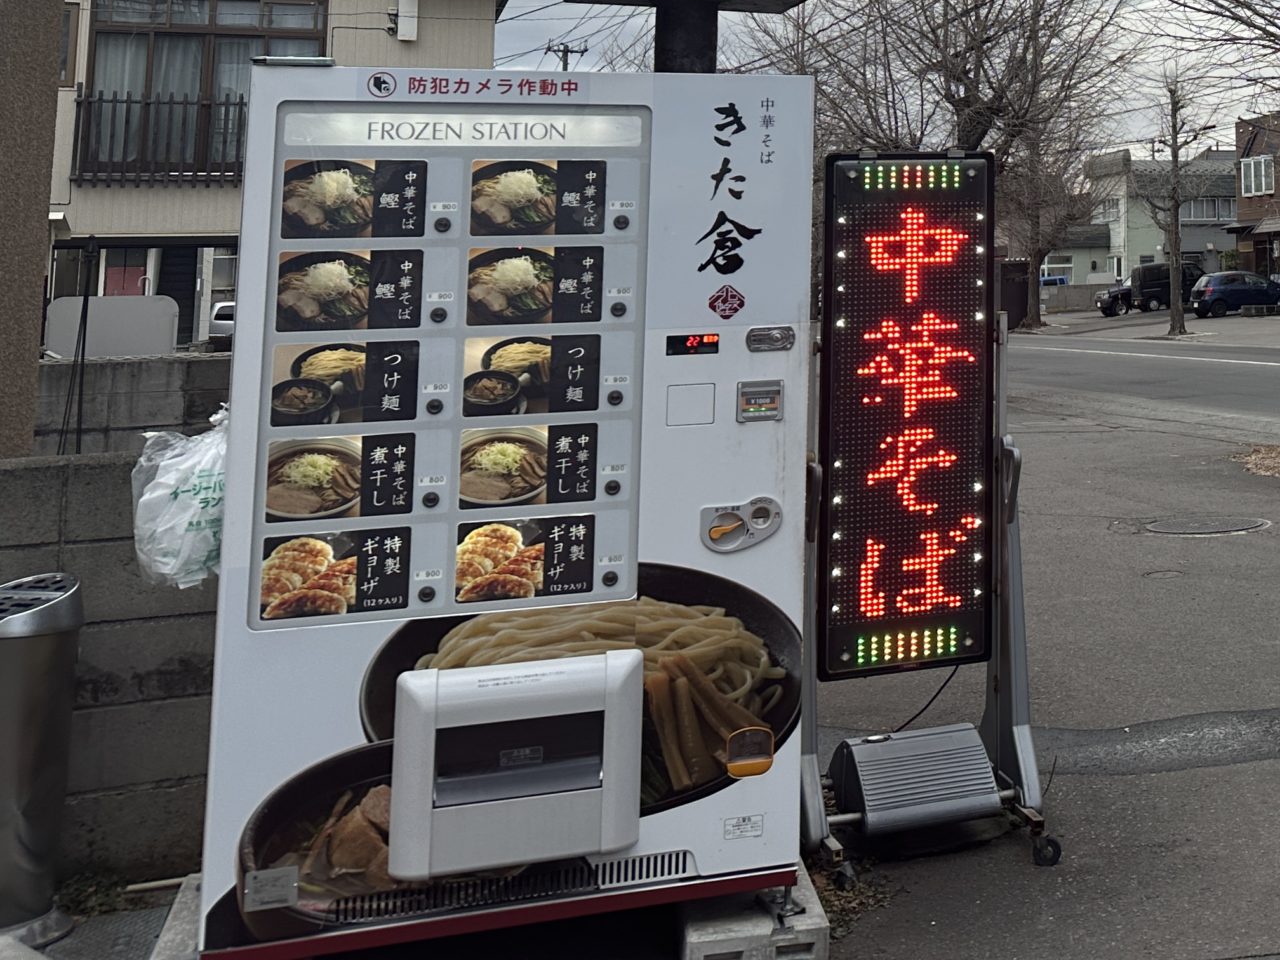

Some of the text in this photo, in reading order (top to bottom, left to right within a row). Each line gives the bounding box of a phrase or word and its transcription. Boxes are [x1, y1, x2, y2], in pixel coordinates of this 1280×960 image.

[408, 77, 579, 97] 防犯カメラ作動中
[367, 122, 567, 141] FROZEN STATION
[760, 97, 776, 164] 中華そば
[402, 171, 417, 229] 中華そば
[583, 170, 597, 227] 中華そば
[695, 102, 763, 275] きた倉
[398, 260, 413, 320] 中華そば
[580, 256, 594, 314] 中華そば
[381, 354, 402, 412] つけ麺
[566, 347, 585, 403] つけ麺
[856, 206, 979, 618] 中華そば
[369, 446, 389, 507] 煮干し
[392, 444, 407, 506] 中華そば
[555, 436, 573, 494] 煮干し
[576, 434, 590, 494] 中華そば
[360, 536, 380, 595] ギョーザ
[383, 535, 403, 575] 特製
[547, 524, 566, 580] ギョーザ
[569, 523, 587, 561] 特製
